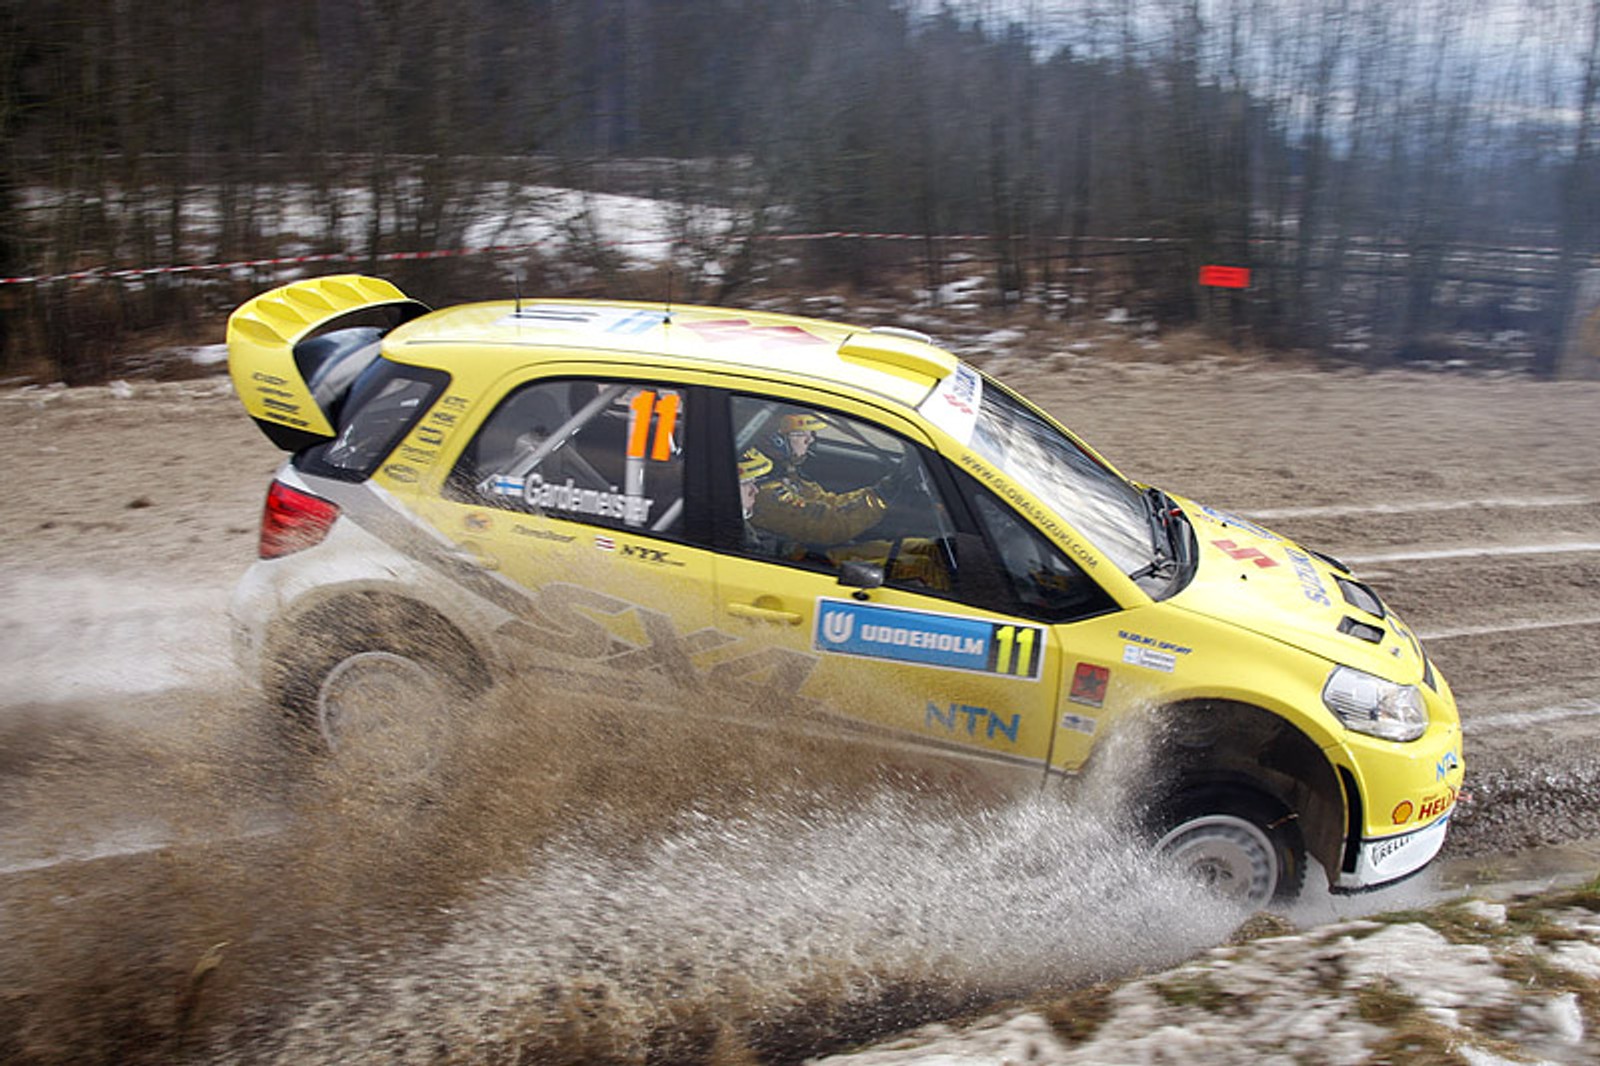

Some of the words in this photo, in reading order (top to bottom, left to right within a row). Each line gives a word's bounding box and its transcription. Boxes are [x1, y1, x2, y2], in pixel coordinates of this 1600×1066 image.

[625, 389, 681, 461] 11
[523, 472, 655, 522] Gardemeister
[861, 623, 985, 656] UDDEHOLM
[996, 625, 1036, 677] 11
[924, 701, 1022, 743] NTN
